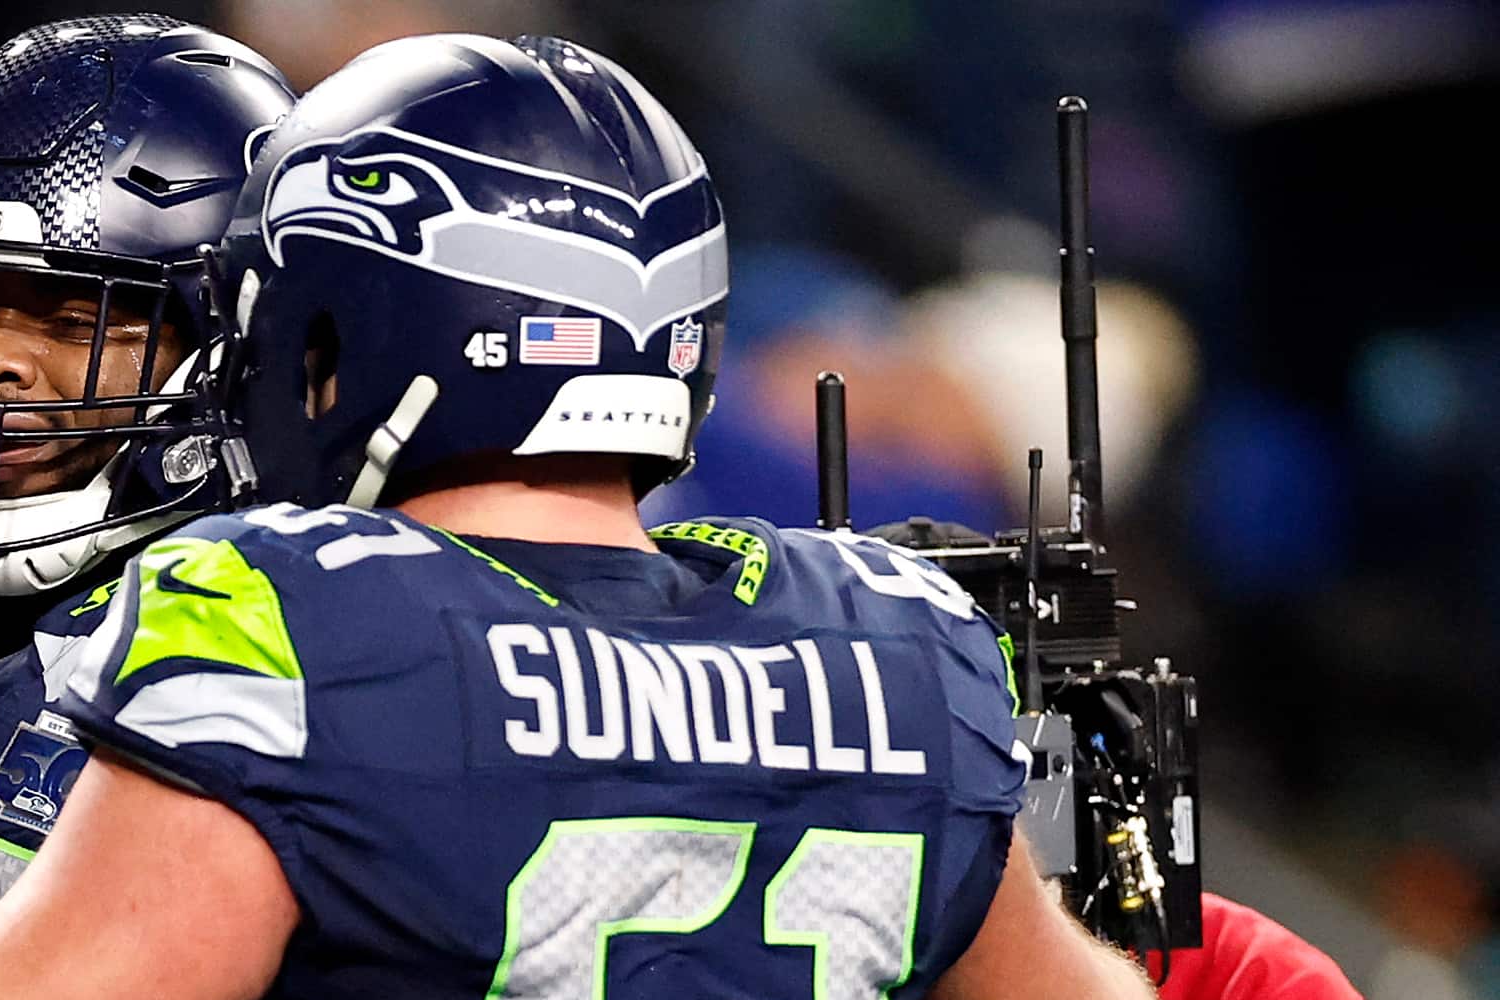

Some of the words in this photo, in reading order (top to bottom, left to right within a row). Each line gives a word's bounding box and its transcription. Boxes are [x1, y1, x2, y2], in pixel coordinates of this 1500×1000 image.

[463, 332, 508, 367] 45
[559, 411, 683, 427] SEATTLE
[486, 624, 926, 775] SUNDELL
